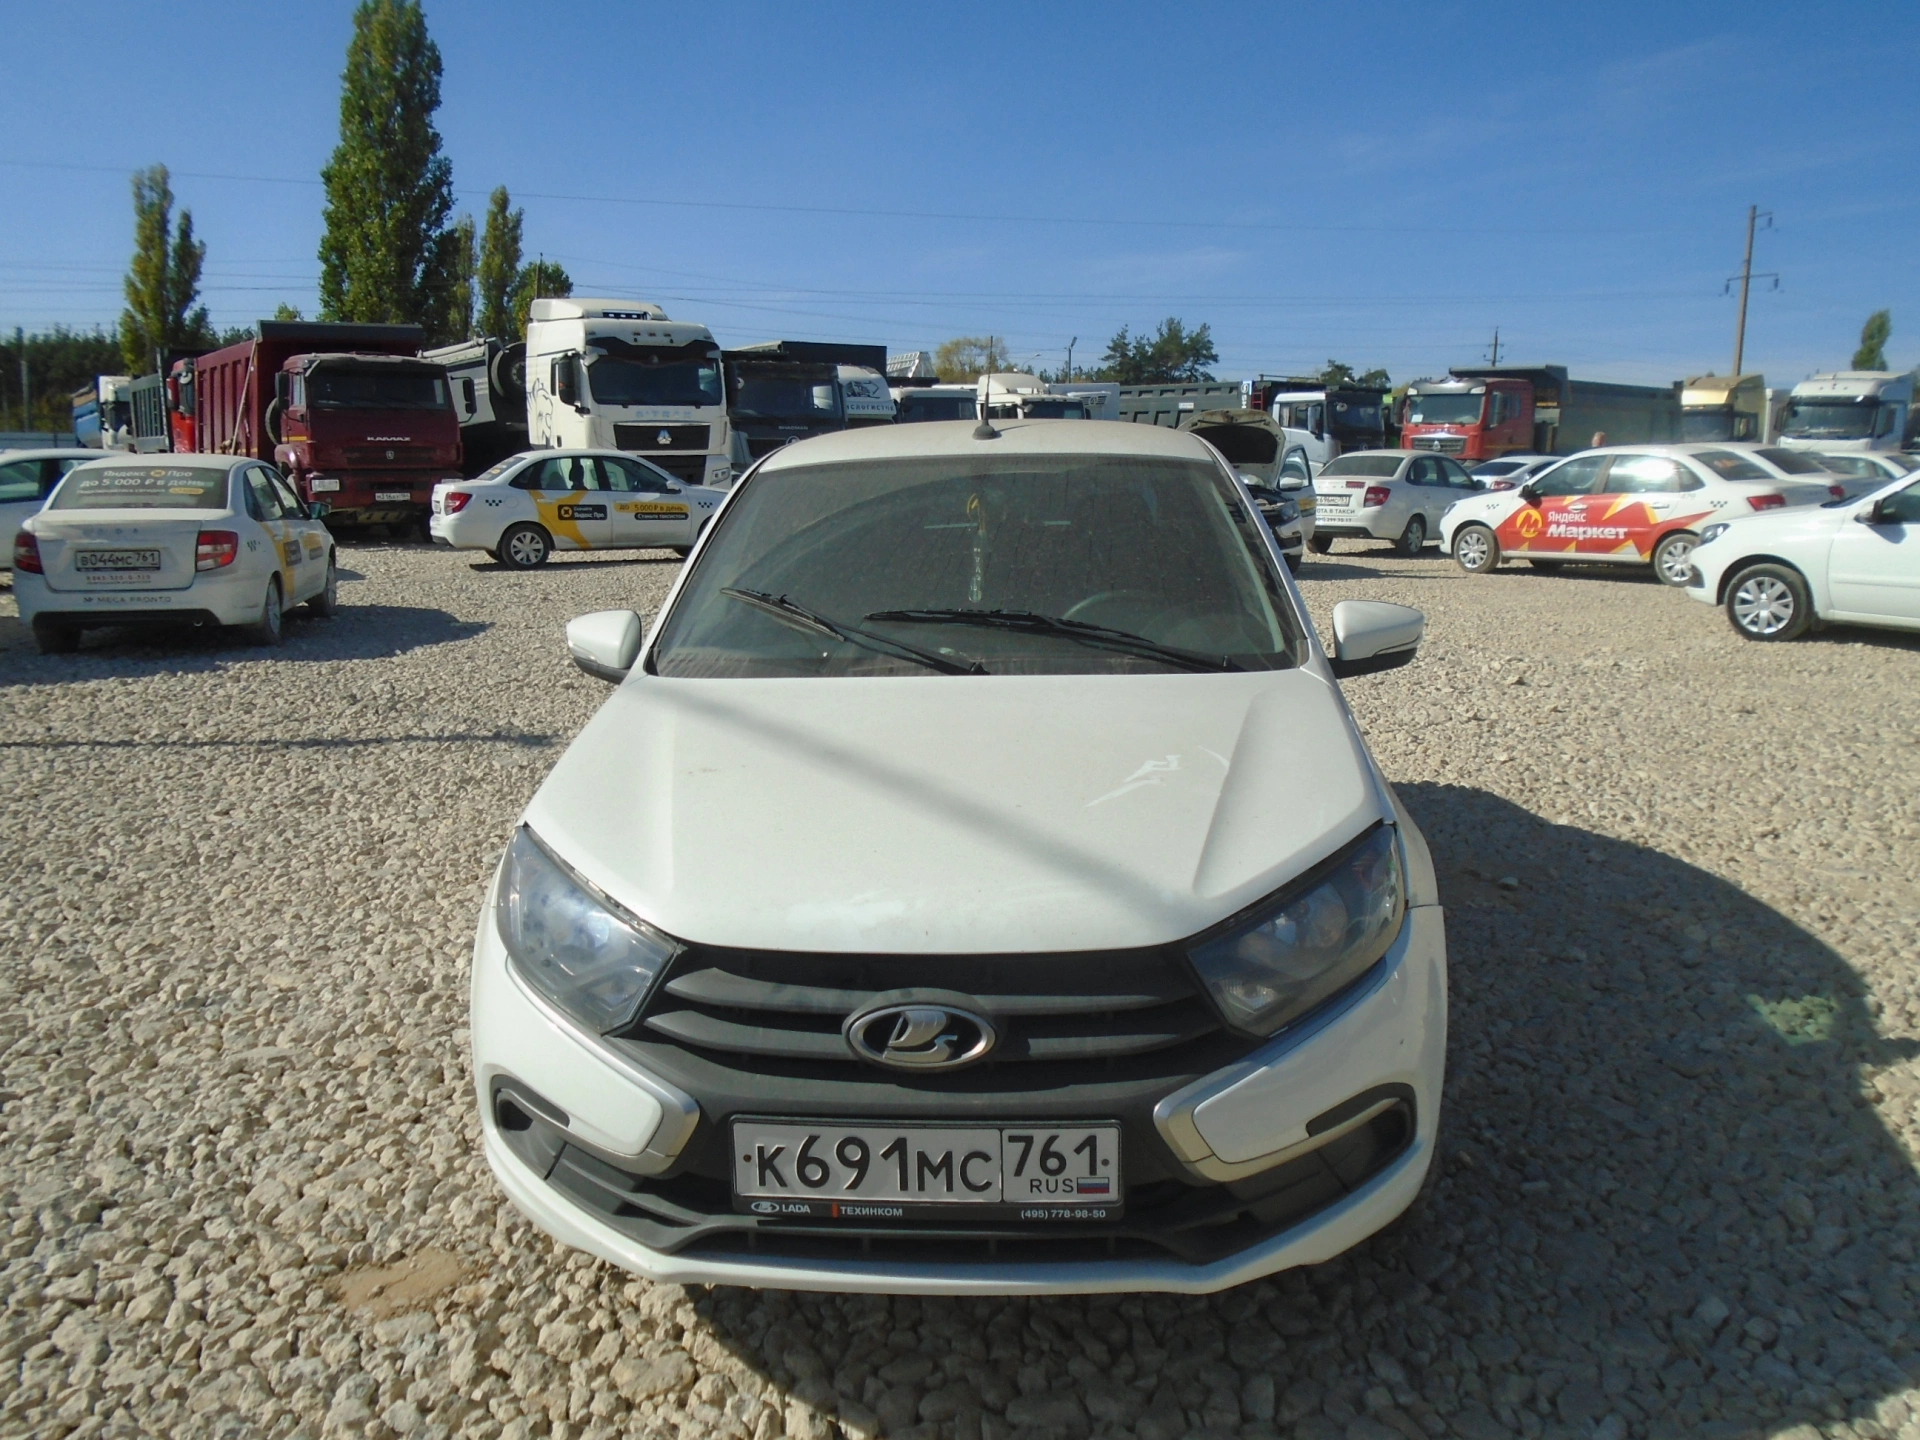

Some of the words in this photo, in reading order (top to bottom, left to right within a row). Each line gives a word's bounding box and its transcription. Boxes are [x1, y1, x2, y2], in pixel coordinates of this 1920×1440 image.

[168, 479, 206, 487] день
[1547, 511, 1587, 523] Яндекс
[1546, 524, 1628, 541] Маркет
[81, 554, 133, 566] В044МС
[135, 553, 156, 563] 761
[756, 1134, 993, 1193] К691МС
[1007, 1135, 1098, 1177] 761
[1029, 1178, 1074, 1194] RUS
[782, 1204, 811, 1214] LADA
[840, 1206, 903, 1217] ТЕХИНКОМ
[1021, 1209, 1048, 1219] (495)
[1051, 1209, 1106, 1218] 778-98-50
